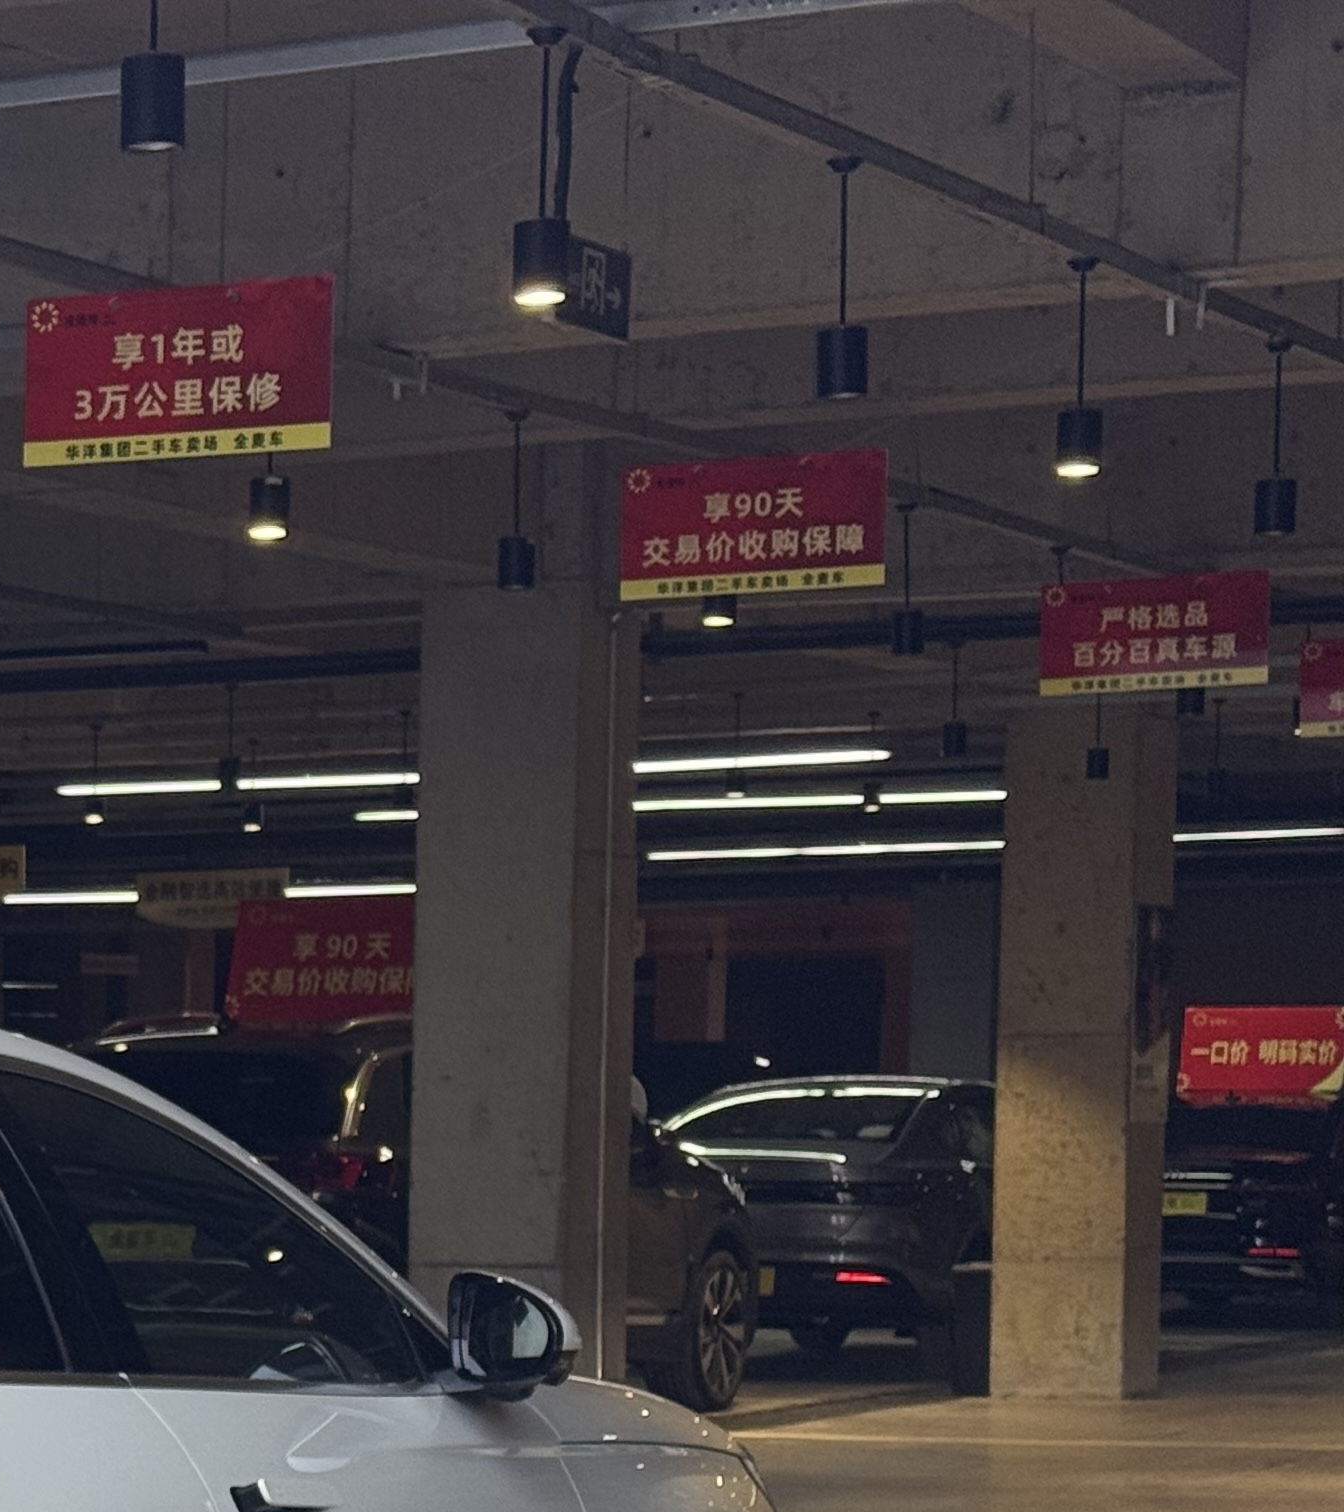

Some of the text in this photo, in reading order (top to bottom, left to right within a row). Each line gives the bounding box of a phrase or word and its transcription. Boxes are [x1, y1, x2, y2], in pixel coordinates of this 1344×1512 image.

[112, 323, 244, 371] 享1年或
[73, 372, 282, 422] 3万公里保修
[65, 435, 218, 460] 华洋集团二手车卖场
[703, 487, 804, 524] 享90天
[642, 523, 865, 568] 交易价收购保障
[1099, 600, 1209, 633] 严格选品
[1072, 633, 1238, 668] 百分百真车源
[1190, 1039, 1339, 1066] 一口价 明码实价
